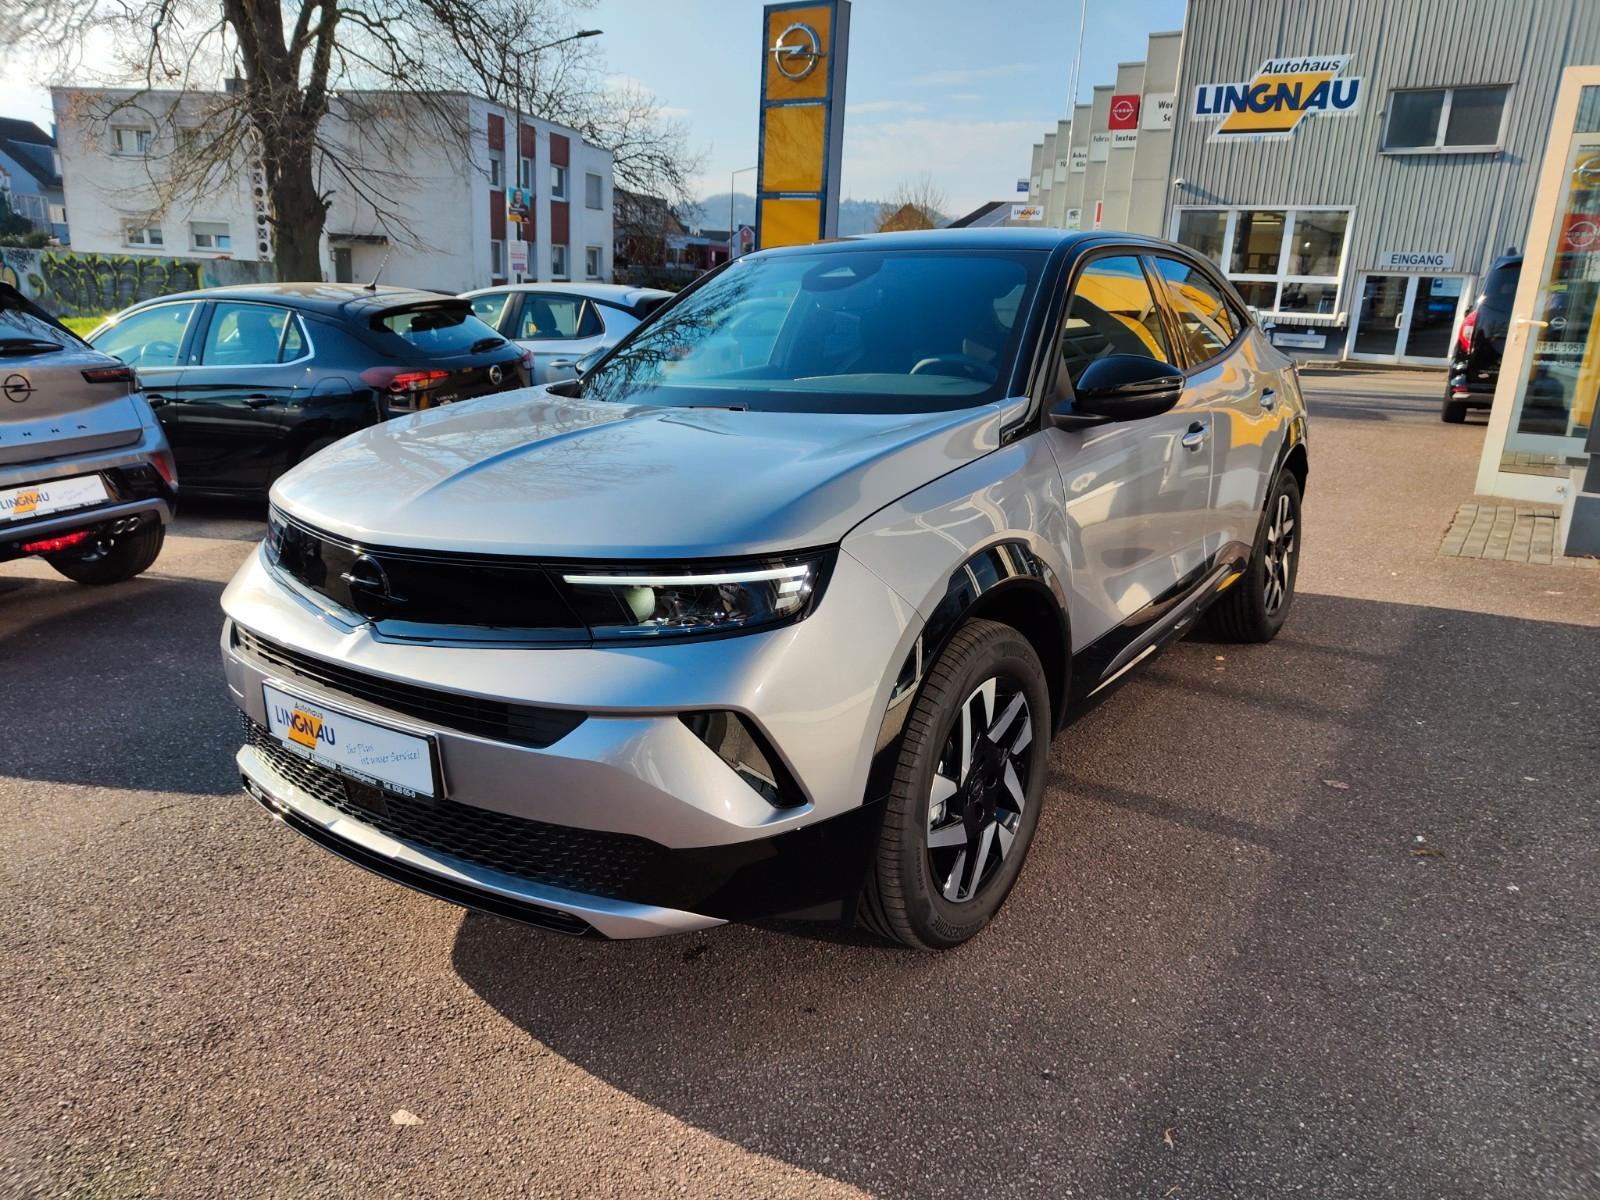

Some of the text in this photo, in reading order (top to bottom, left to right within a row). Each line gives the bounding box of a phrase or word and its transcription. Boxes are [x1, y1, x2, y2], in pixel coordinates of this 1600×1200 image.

[1261, 58, 1341, 75] Autohaus
[1196, 79, 1360, 114] LINGNAU
[1390, 253, 1444, 266] EINGANG
[0, 491, 50, 510] LINGNAU
[275, 705, 336, 746] LINGNAU
